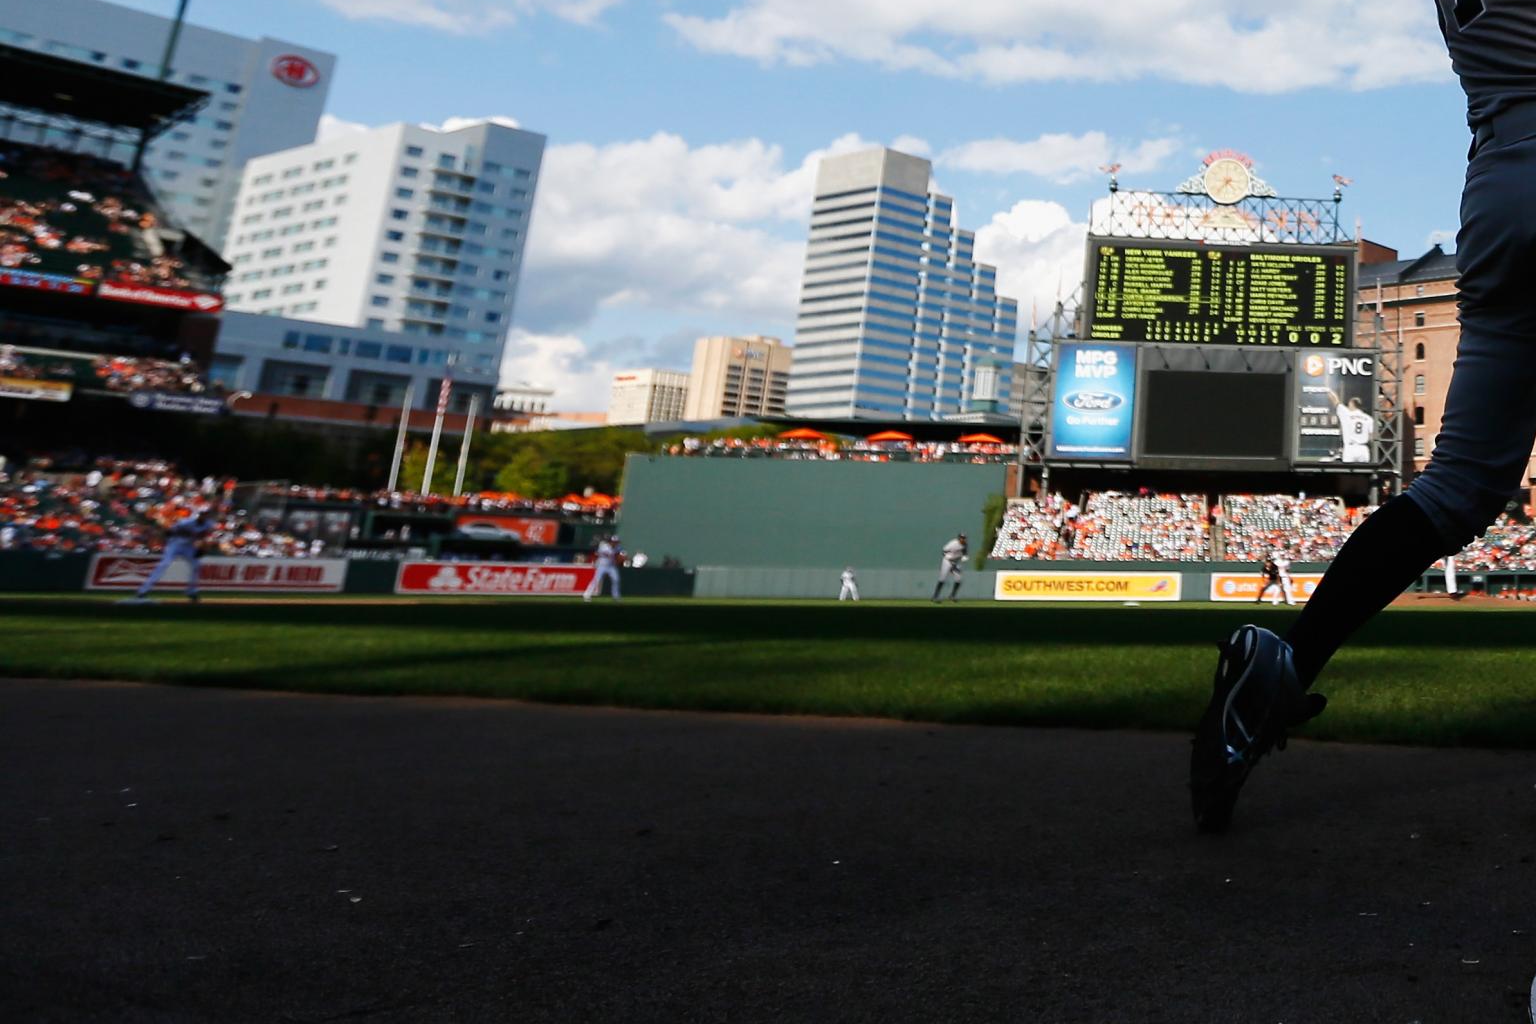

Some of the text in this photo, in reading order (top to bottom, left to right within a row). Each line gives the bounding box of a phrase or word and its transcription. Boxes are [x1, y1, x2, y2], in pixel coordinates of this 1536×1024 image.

[1124, 248, 1141, 256] NEW
[1142, 249, 1162, 257] YORK
[1163, 250, 1198, 258] YANKEES
[1250, 254, 1290, 262] BALTIMORE
[1288, 332, 1342, 344] 0 0 2
[1075, 350, 1118, 365] MPG
[1075, 364, 1117, 378] MVP
[1327, 357, 1373, 376] PNC
[1073, 392, 1114, 410] Ford
[1355, 422, 1363, 434] 8
[1003, 580, 1129, 592] SOUTHWEST.COM
